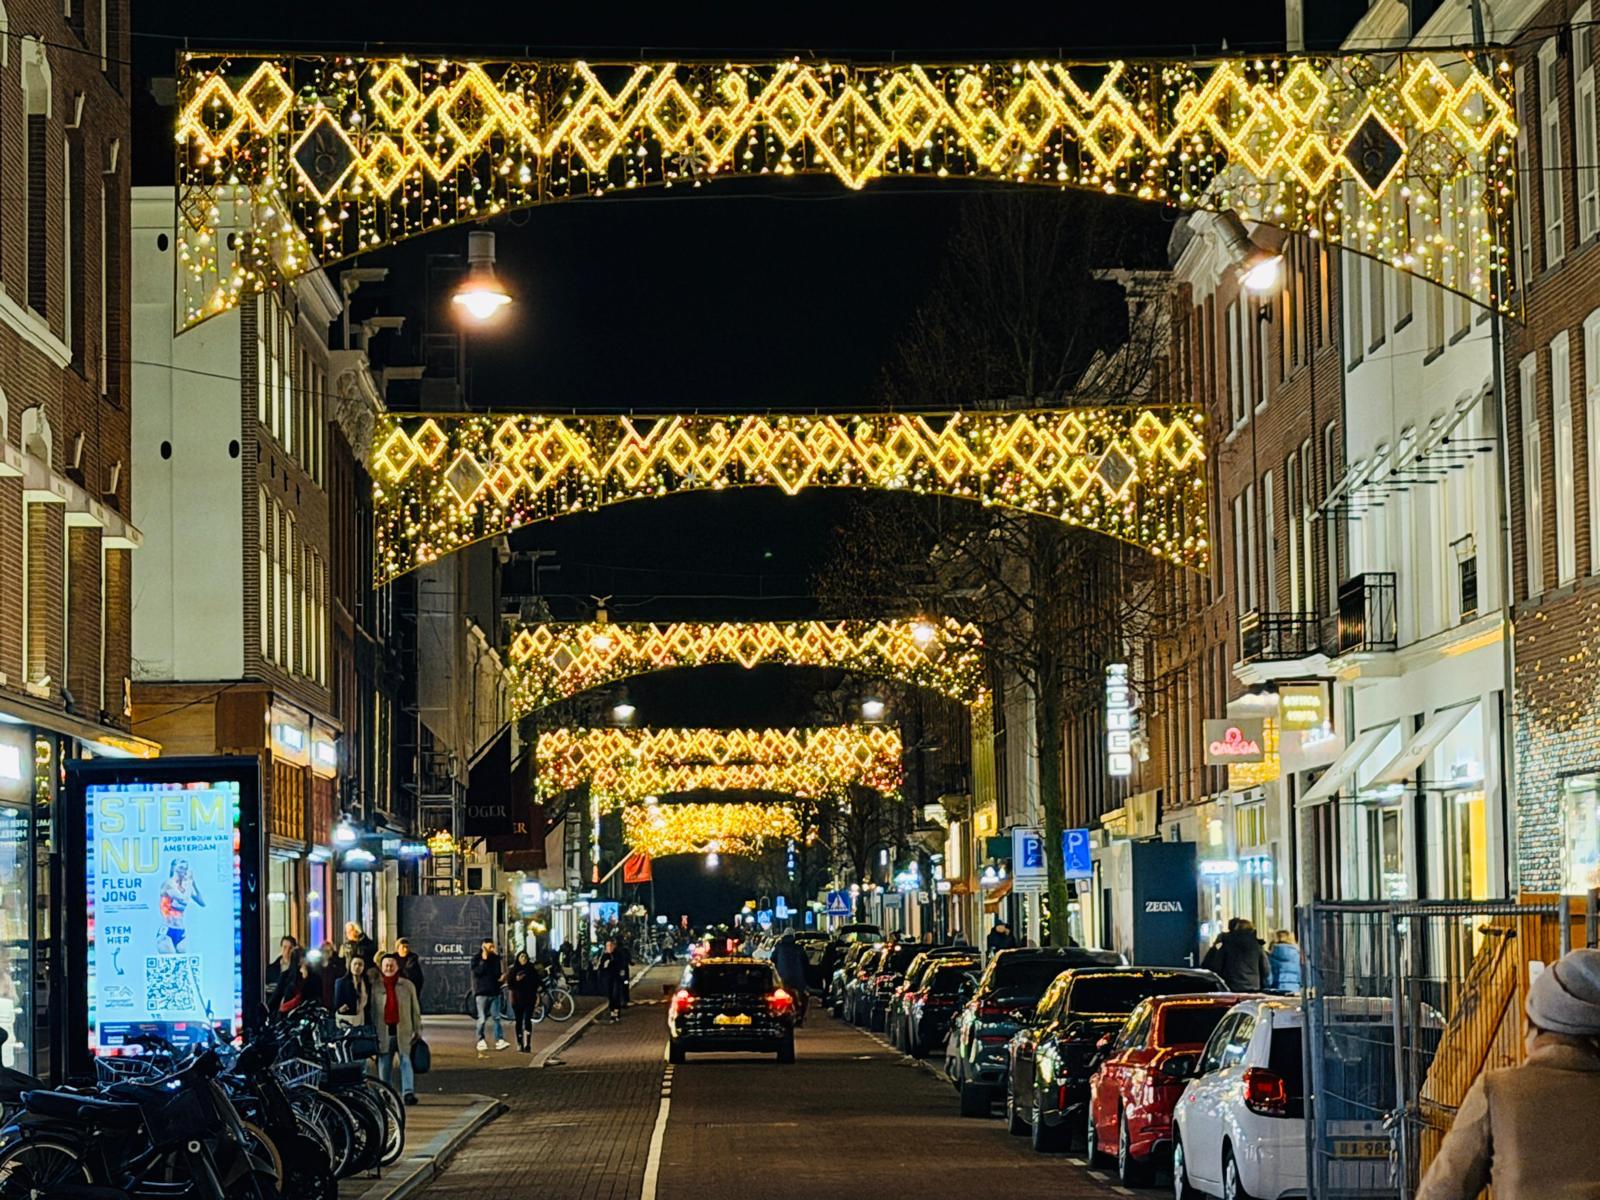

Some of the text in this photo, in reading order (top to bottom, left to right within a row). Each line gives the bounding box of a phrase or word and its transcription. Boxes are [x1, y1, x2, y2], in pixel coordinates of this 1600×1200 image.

[1209, 740, 1260, 756] OMEGA
[100, 795, 225, 833] STEM
[468, 804, 507, 818] OGER
[214, 834, 229, 842] VAN
[163, 843, 217, 853] AMSTERDAM
[101, 836, 160, 874] NU
[102, 878, 142, 889] FLEUR
[102, 890, 136, 902] JONG
[1145, 901, 1183, 913] ZEGNA
[104, 926, 132, 935] STEM
[106, 936, 130, 944] HIER
[434, 943, 464, 955] OGER
